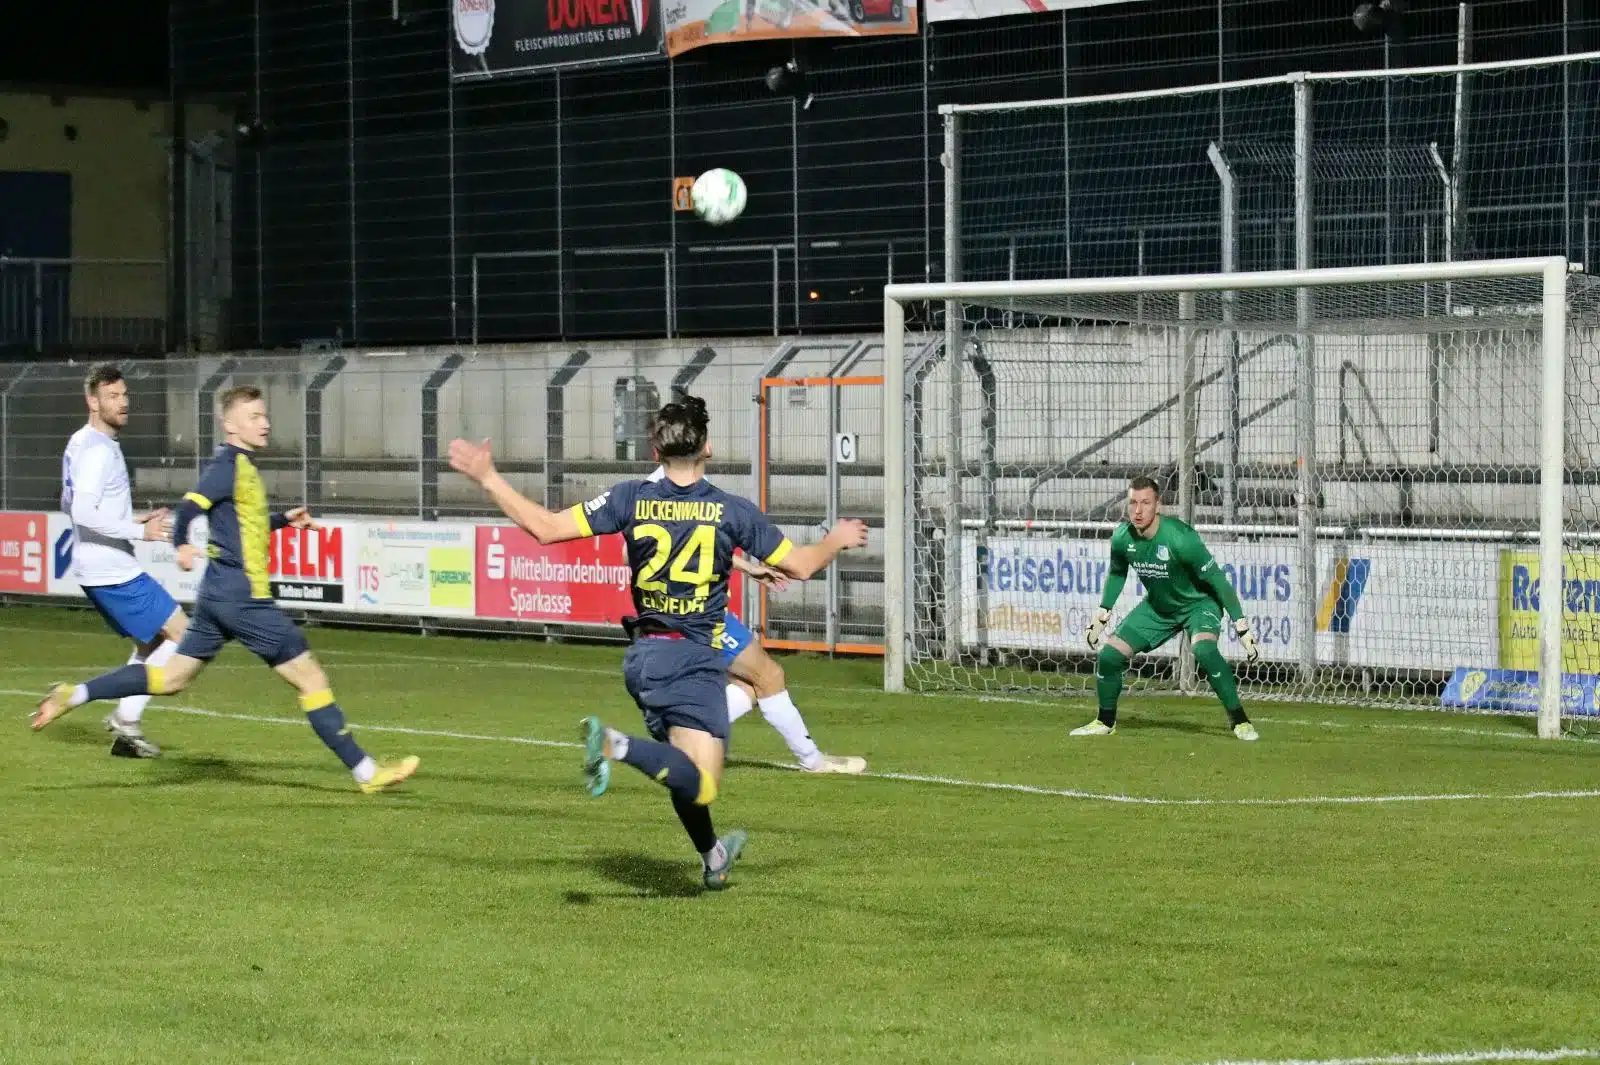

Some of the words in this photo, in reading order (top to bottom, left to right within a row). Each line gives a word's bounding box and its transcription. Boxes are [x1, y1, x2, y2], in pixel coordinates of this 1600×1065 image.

[514, 31, 605, 51] FLEISCHPRODUKTIONS
[606, 27, 632, 42] GMBH
[840, 435, 850, 460] C
[635, 500, 724, 522] LUCKENWALDE
[633, 524, 720, 597] 24
[978, 546, 1108, 594] Reisebür
[358, 565, 379, 592] ITS
[511, 587, 572, 616] Sparkasse
